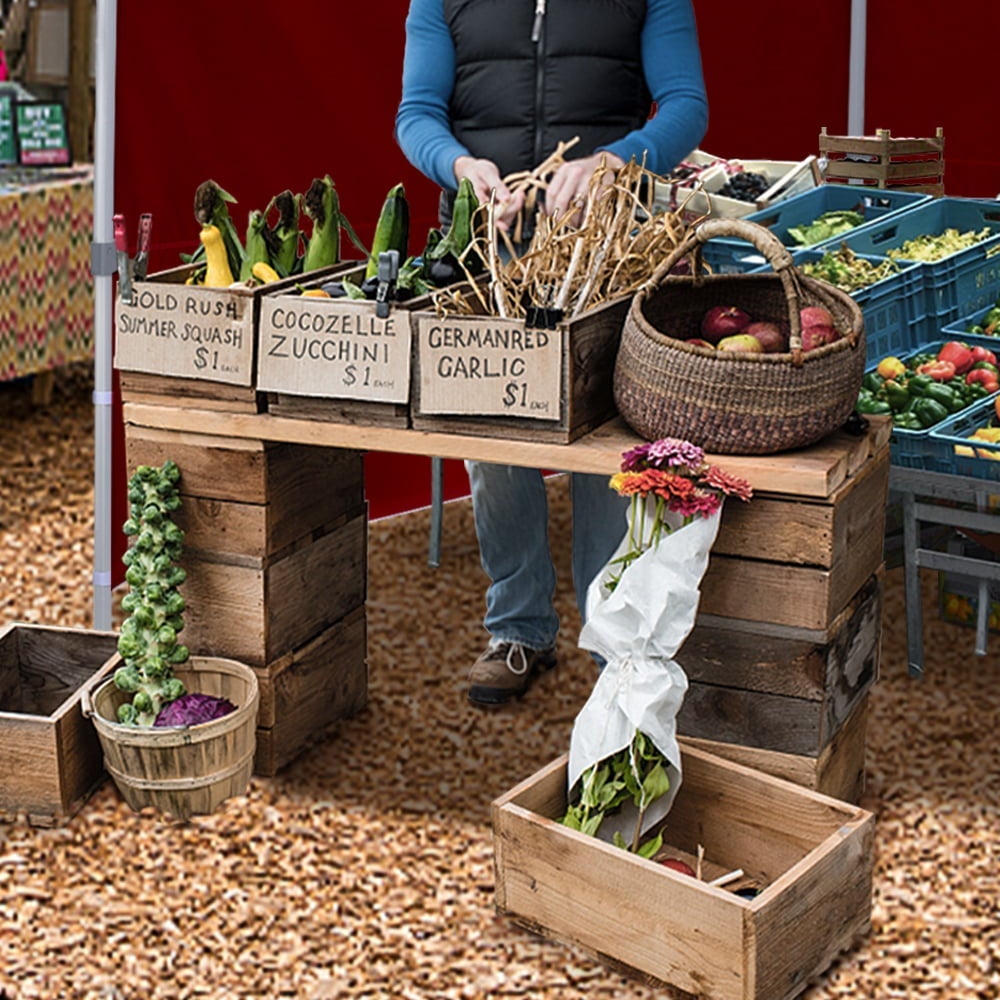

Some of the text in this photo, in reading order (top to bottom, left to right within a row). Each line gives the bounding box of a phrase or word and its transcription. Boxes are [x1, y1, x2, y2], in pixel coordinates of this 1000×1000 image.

[185, 297, 238, 320] RUSH
[119, 313, 243, 349] SUMMER SQUASH
[271, 308, 397, 337] COCOZELLE
[193, 346, 219, 370] $1
[268, 334, 389, 364] ZUCCHINI
[342, 364, 371, 387] $1
[437, 355, 526, 379] GARLIC
[502, 380, 528, 409] $1
